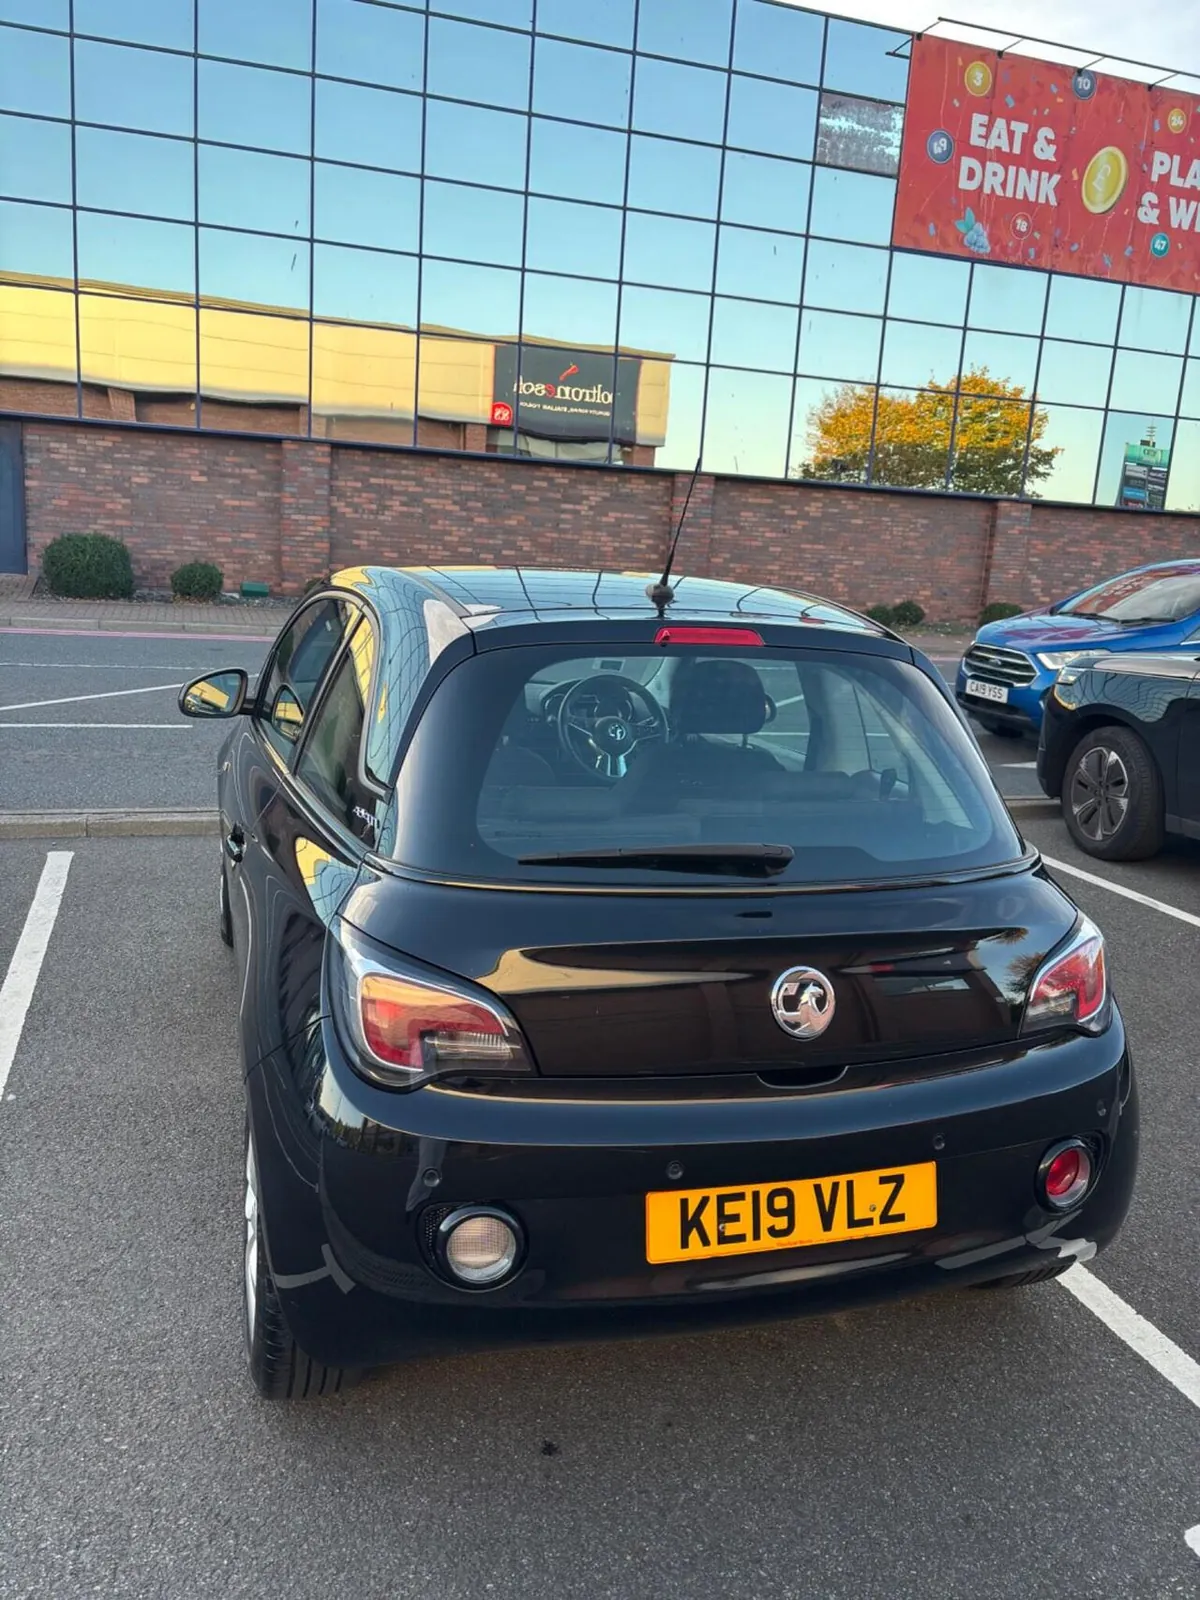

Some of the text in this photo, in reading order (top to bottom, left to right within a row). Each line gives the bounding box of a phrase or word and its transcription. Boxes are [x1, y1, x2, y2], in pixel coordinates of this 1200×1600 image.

[969, 112, 1057, 162] EAT &
[958, 156, 1061, 206] DRINK
[1137, 191, 1160, 225] &
[679, 1173, 906, 1250] KE19 VLZ
